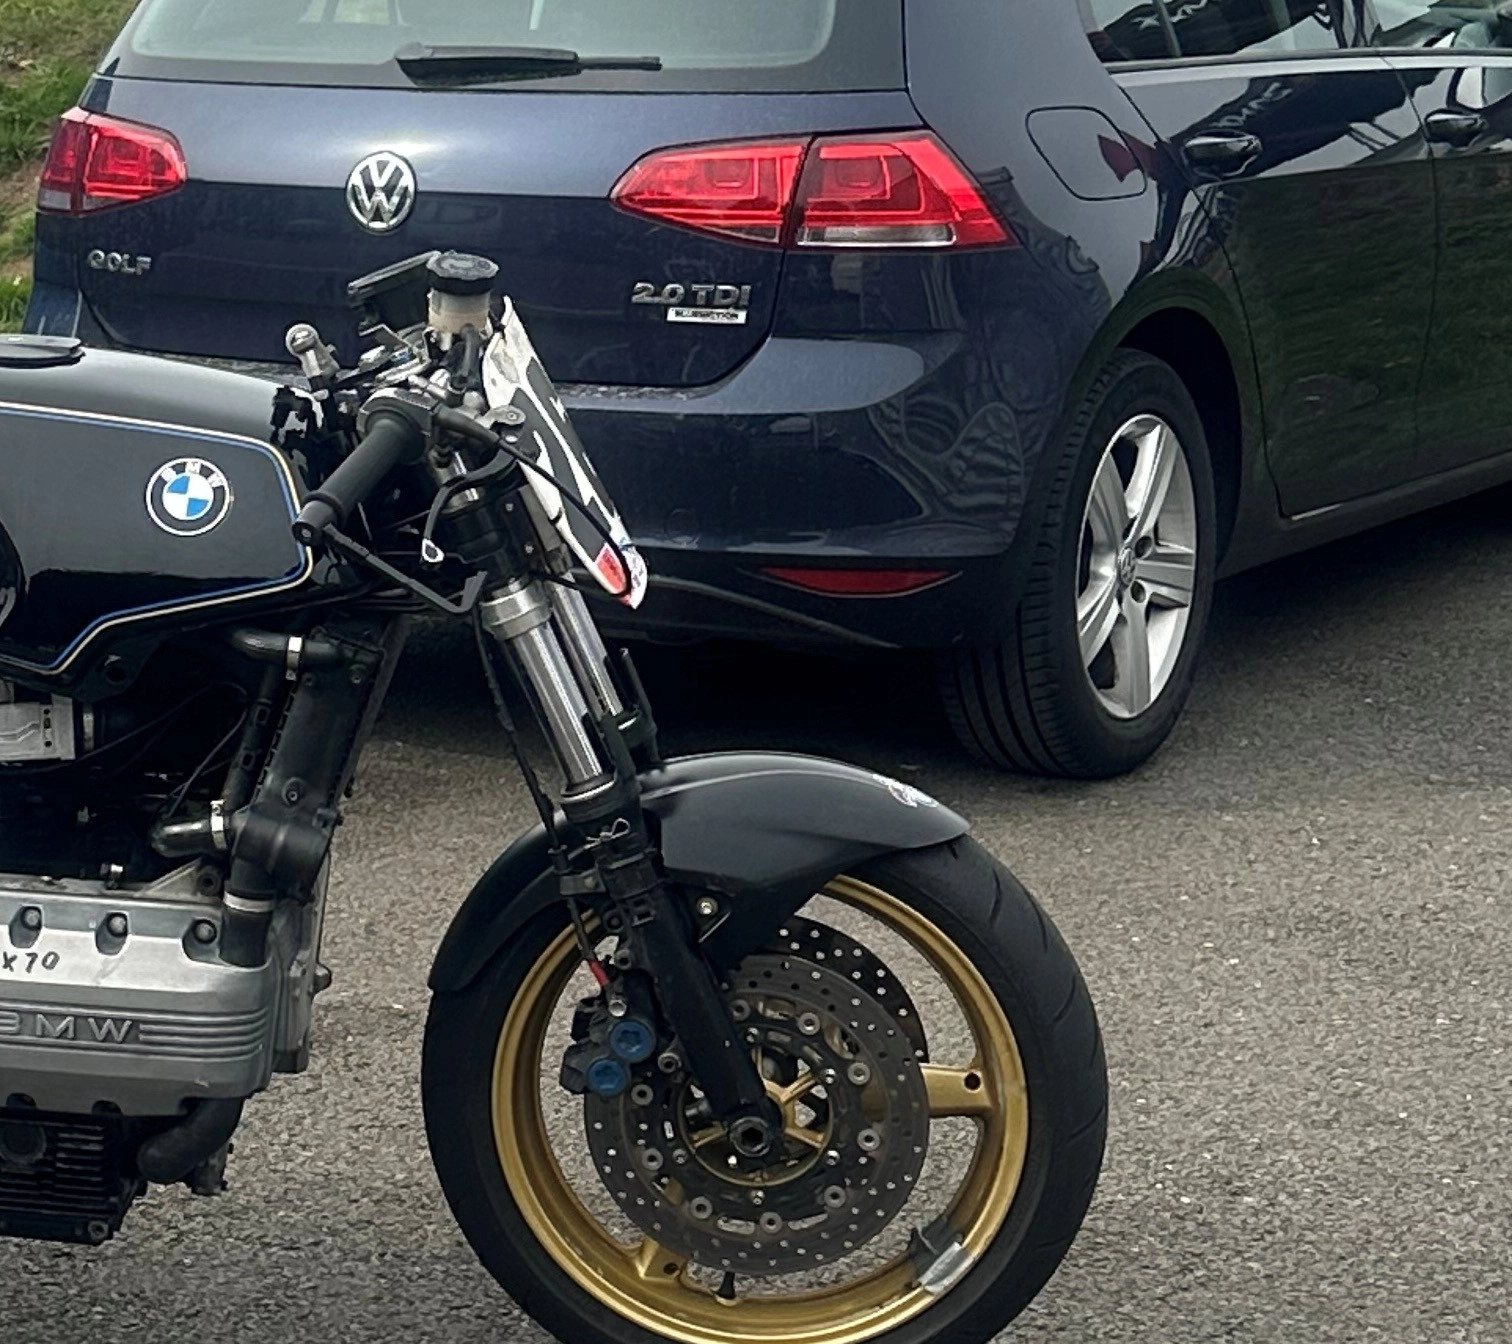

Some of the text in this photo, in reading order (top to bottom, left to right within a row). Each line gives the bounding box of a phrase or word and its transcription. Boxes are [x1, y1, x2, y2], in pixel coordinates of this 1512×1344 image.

[88, 249, 152, 276] GOLF
[631, 282, 751, 306] 2.0 TDI
